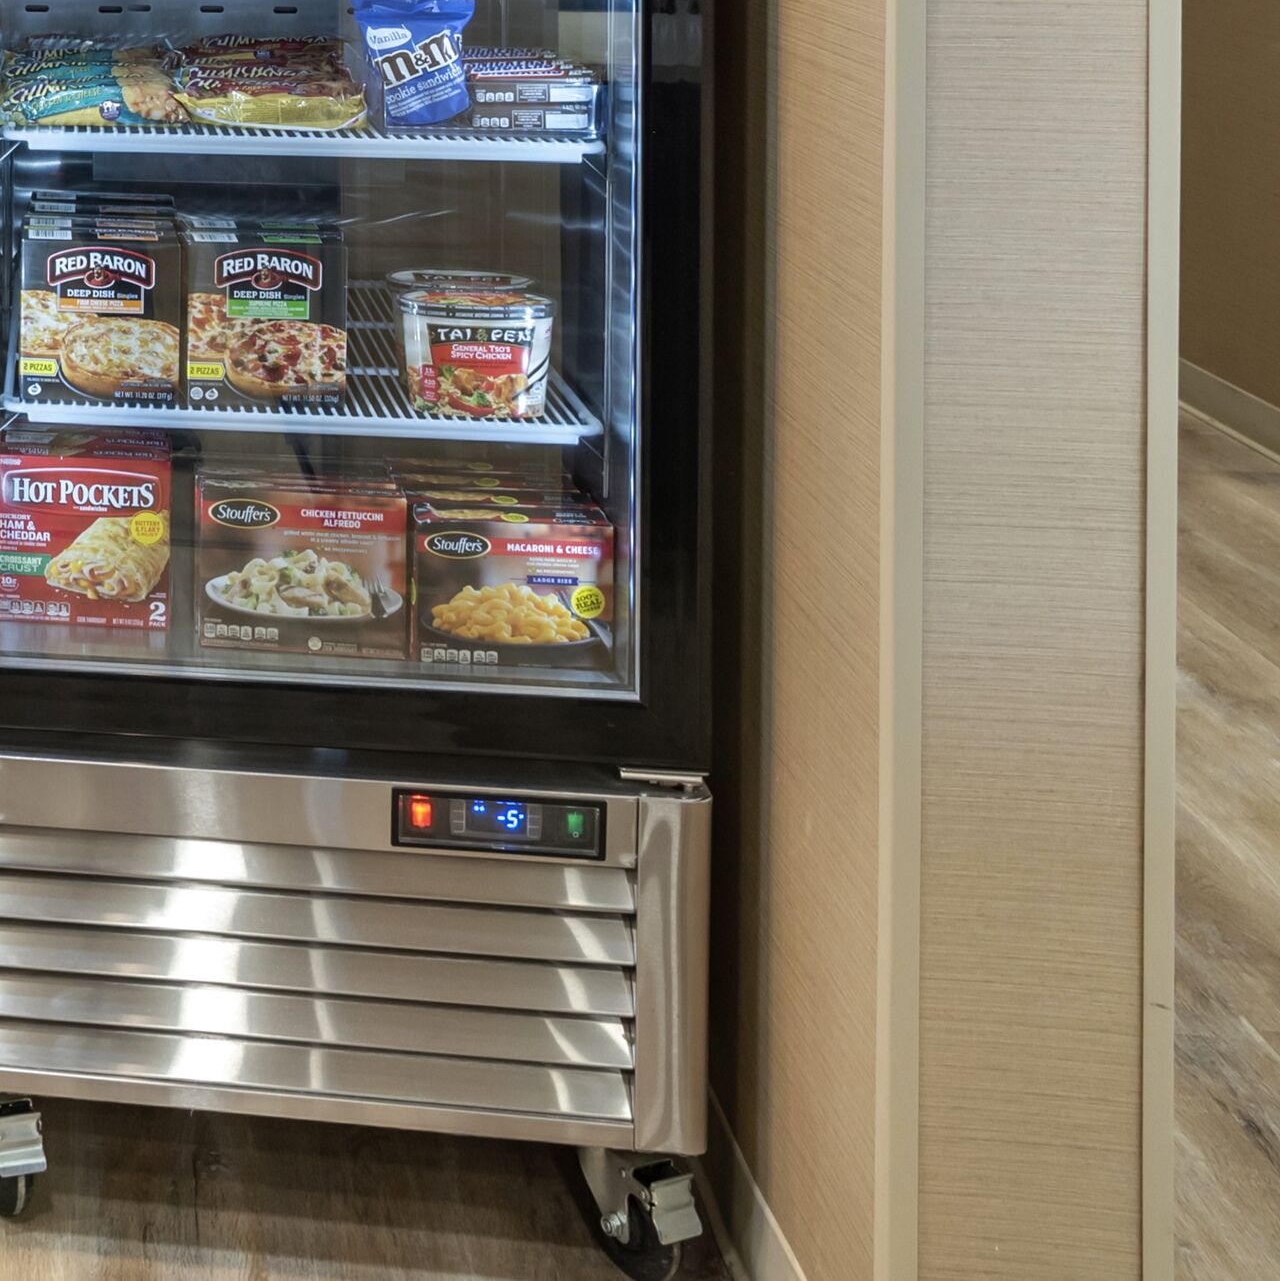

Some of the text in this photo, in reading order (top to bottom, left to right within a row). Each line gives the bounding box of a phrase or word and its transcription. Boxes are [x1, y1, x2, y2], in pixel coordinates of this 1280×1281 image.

[368, 30, 408, 46] Vanilla
[418, 65, 463, 90] sandwich
[55, 252, 146, 278] RED BARON
[223, 254, 313, 280] RED BARON
[67, 289, 115, 299] DEEP DISH
[234, 290, 281, 299] DEEP DISH
[438, 328, 471, 340] TAI
[489, 345, 511, 353] TSO'S
[450, 350, 511, 360] SPICY CHICKEN
[29, 363, 53, 371] PIZZAS
[196, 367, 219, 375] PIZZAS
[13, 478, 155, 508] HOT POCKETS
[216, 505, 272, 523] Stouffer's
[301, 509, 384, 521] CHICKEN FETTUCCINI
[0, 520, 35, 531] HAM &
[323, 519, 360, 528] ALFREDO
[0, 530, 50, 541] CHEDDAR
[433, 537, 483, 554] Stouffer's
[507, 543, 599, 555] MACARONI & CHEESE
[0, 555, 42, 565] CROISSANT
[0, 564, 39, 572] CRUST
[575, 599, 602, 610] REAL
[149, 602, 165, 621] 2
